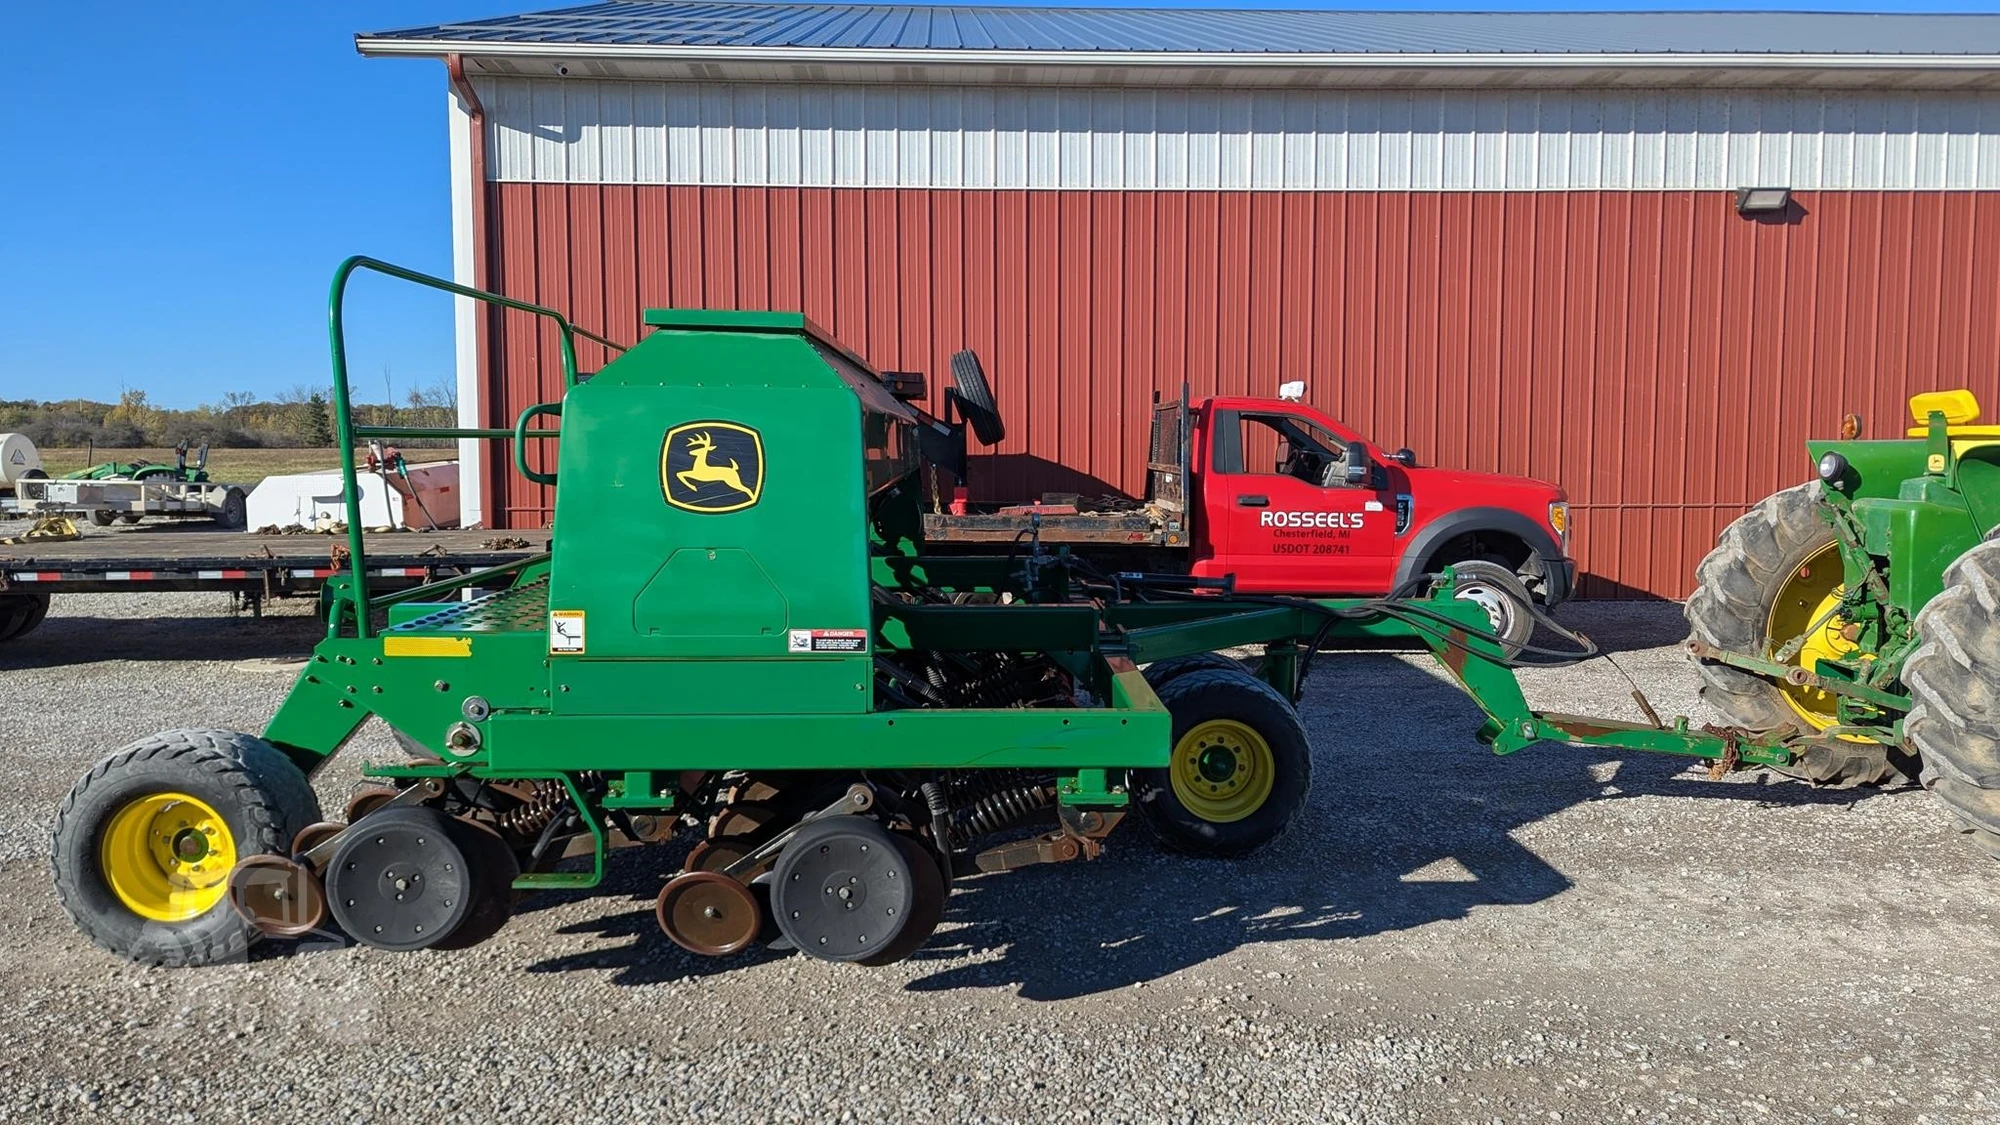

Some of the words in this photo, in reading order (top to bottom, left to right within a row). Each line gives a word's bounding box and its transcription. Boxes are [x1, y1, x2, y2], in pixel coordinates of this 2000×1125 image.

[1260, 511, 1364, 528] ROSSEEL'S
[1273, 529, 1336, 539] Chesterfield,
[1338, 530, 1351, 539] MI
[1273, 544, 1310, 554] USDOT
[1313, 545, 1350, 554] 208741
